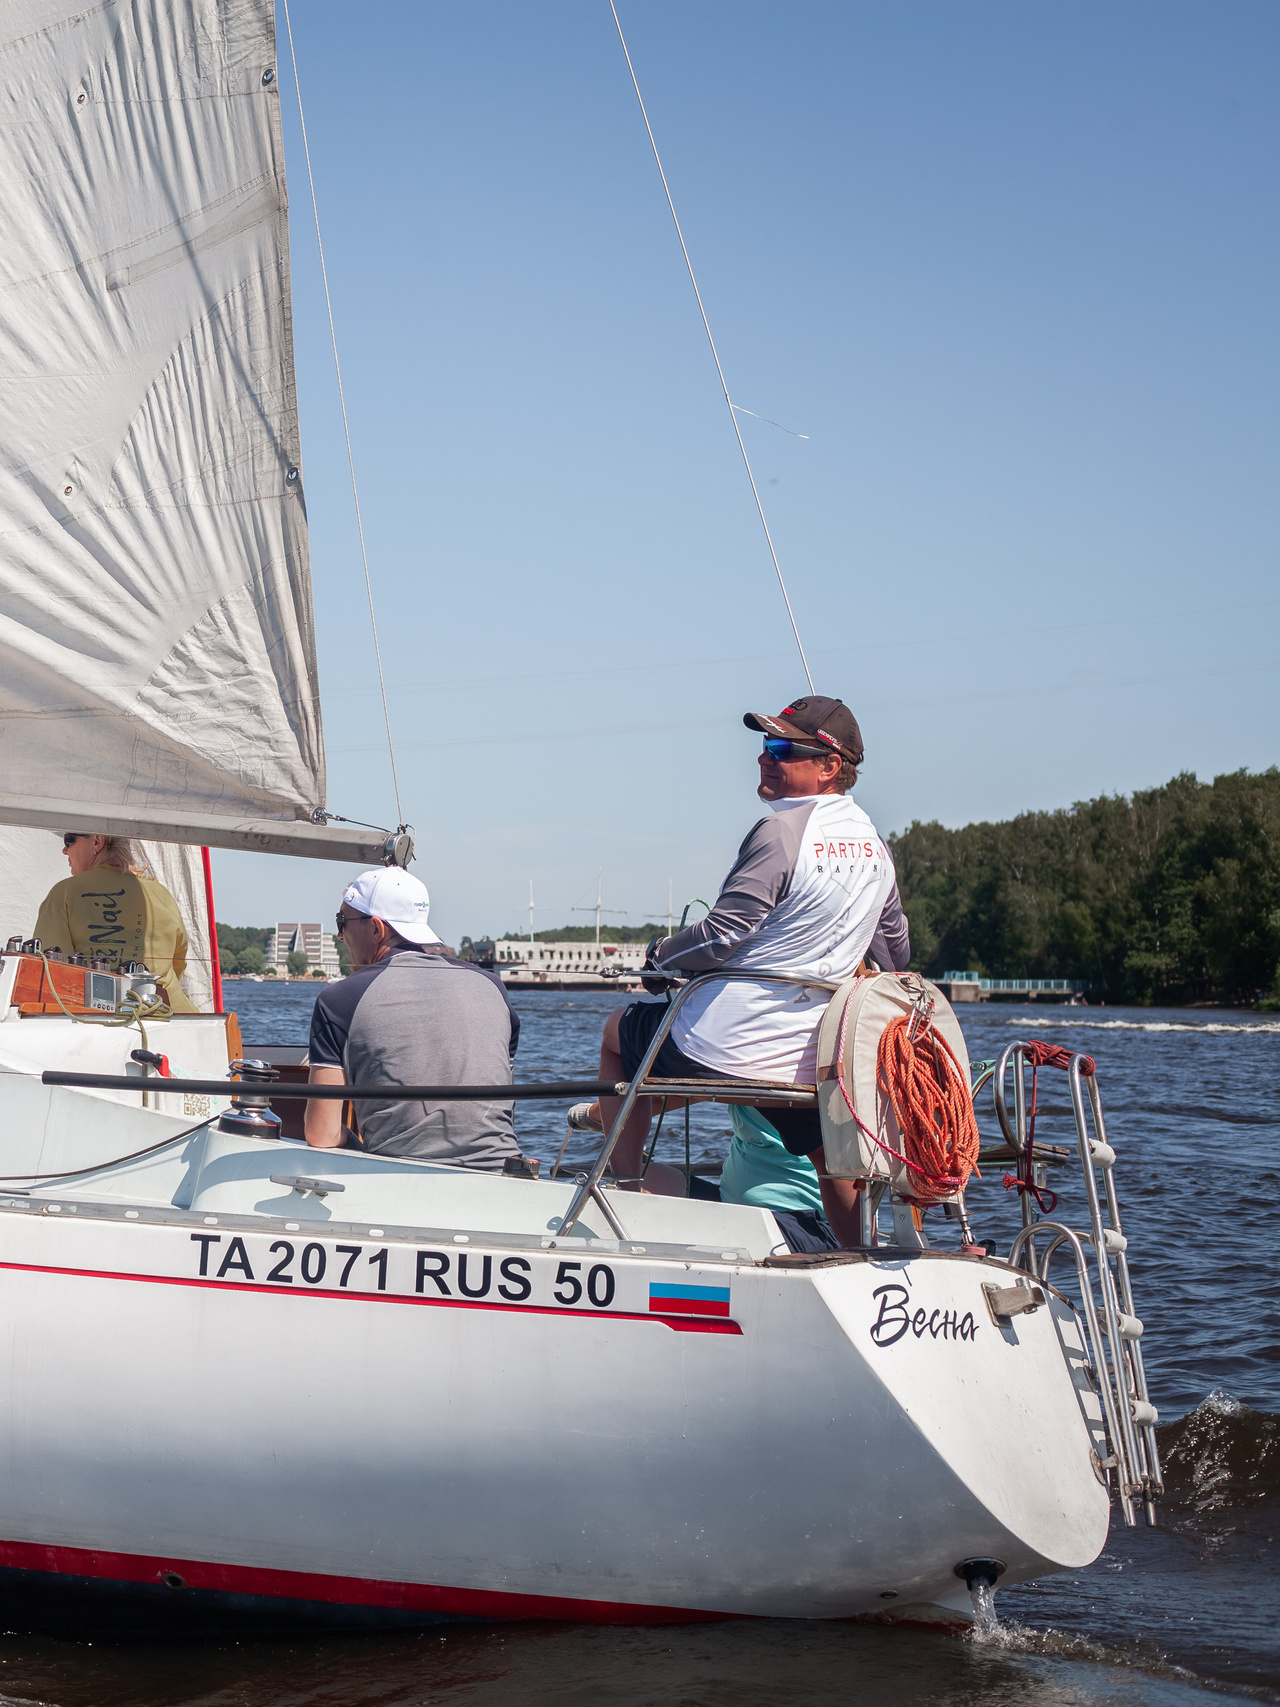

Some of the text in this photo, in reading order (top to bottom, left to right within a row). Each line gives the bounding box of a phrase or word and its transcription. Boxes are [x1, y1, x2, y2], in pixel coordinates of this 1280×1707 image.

[190, 1233, 616, 1308] TA 2071 RUS 50
[870, 1284, 980, 1348] Весна
